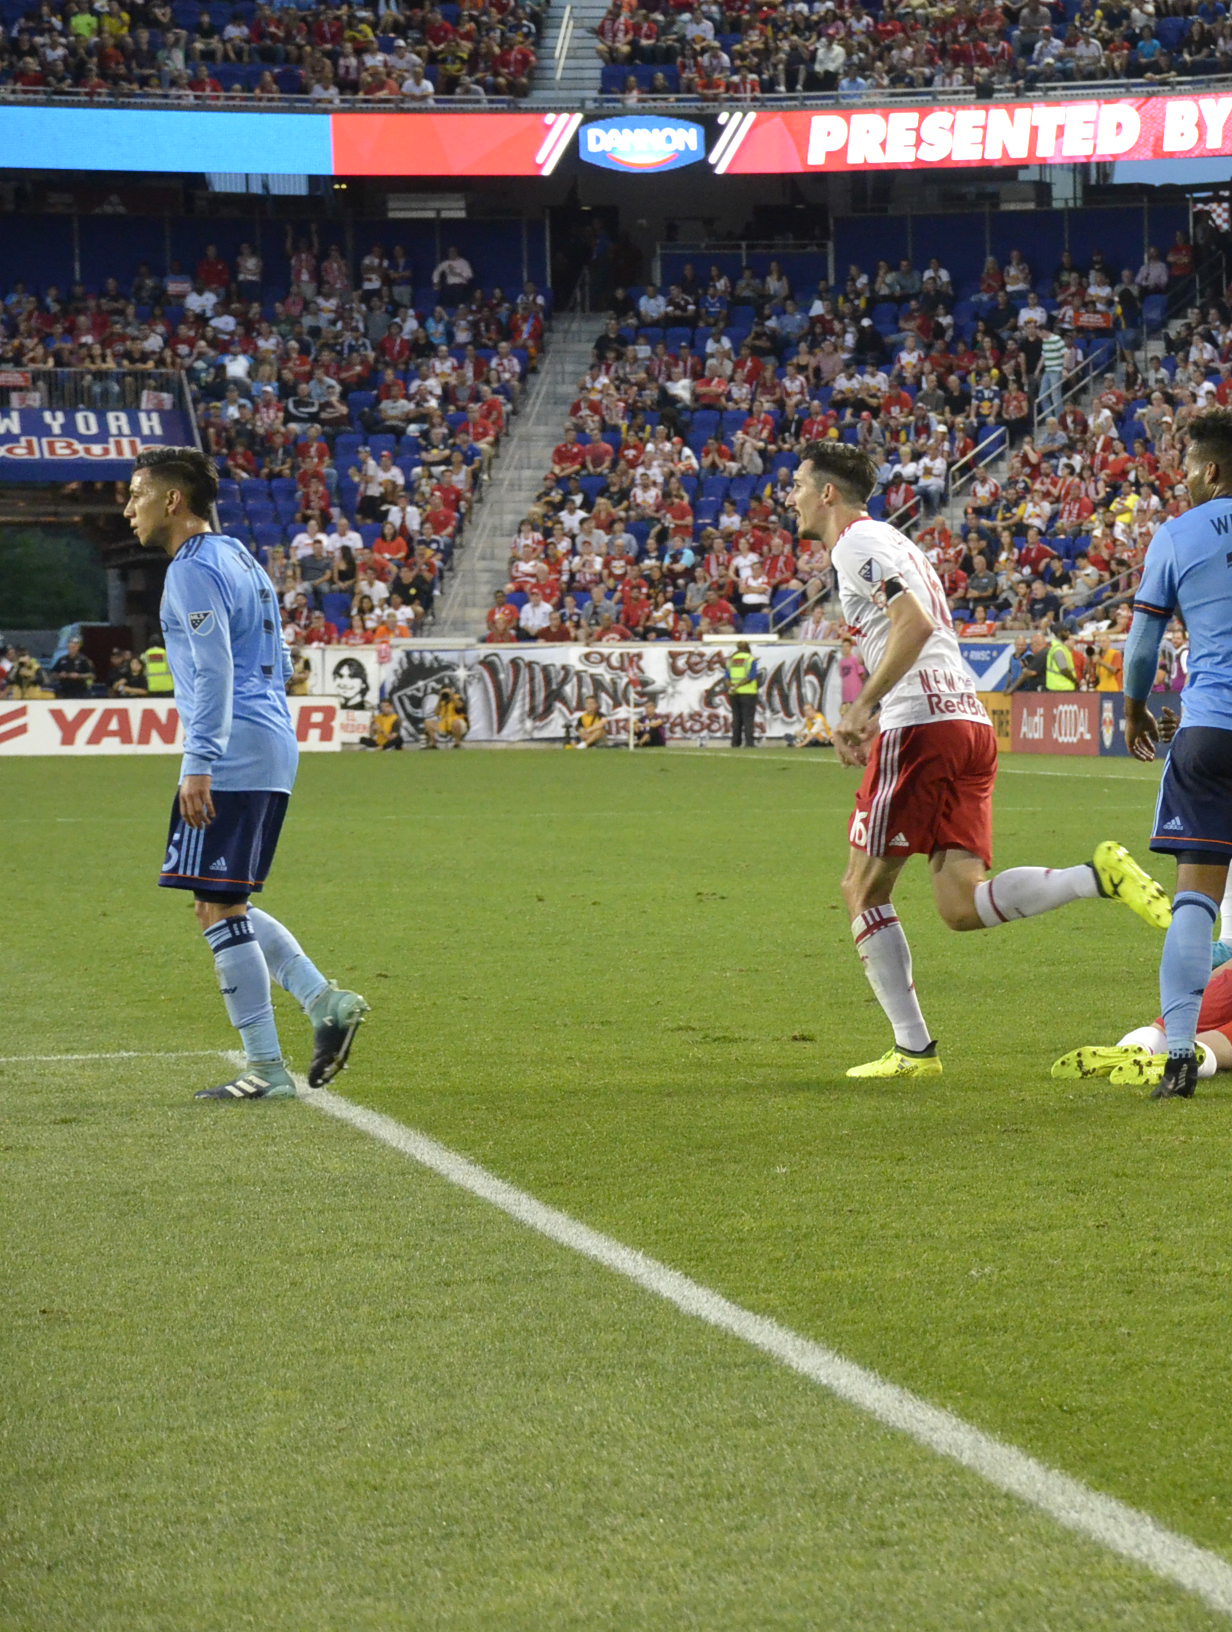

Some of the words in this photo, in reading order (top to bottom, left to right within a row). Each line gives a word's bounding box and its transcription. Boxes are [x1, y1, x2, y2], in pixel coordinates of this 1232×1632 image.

[587, 128, 698, 152] DANNON
[807, 103, 1141, 165] PRESENTED
[42, 410, 164, 436] YORK
[42, 436, 165, 460] Bull
[579, 651, 645, 675] OUR
[479, 652, 660, 734] VIKING
[919, 669, 956, 693] NEW
[927, 693, 968, 716] Red
[48, 705, 337, 746] YANR
[1020, 706, 1044, 740] Audi
